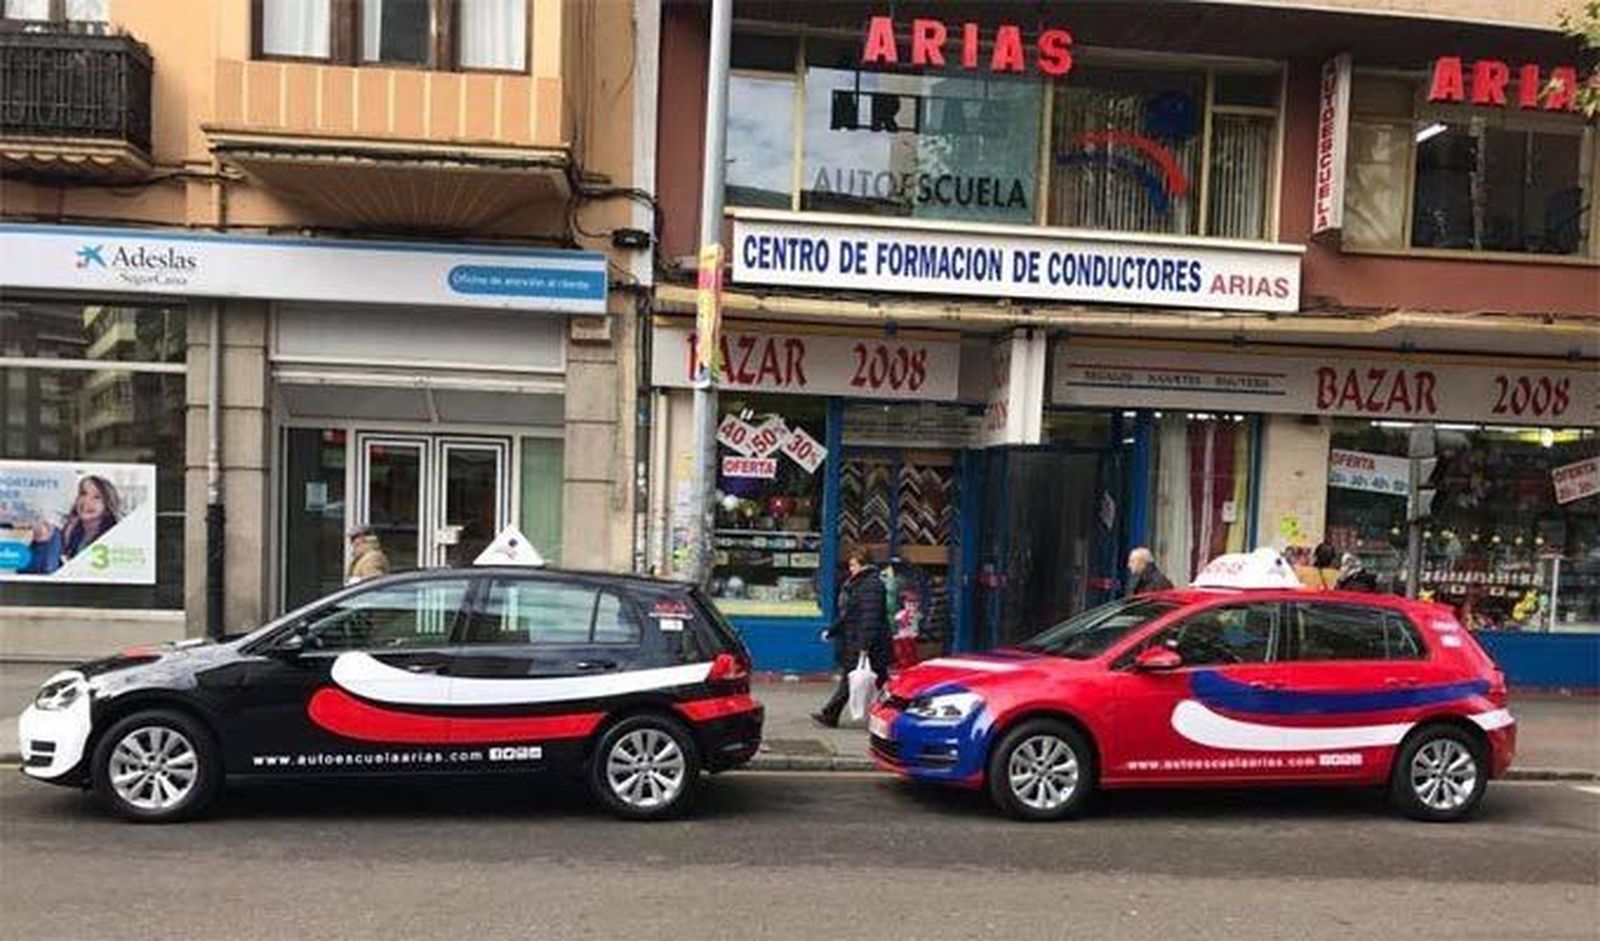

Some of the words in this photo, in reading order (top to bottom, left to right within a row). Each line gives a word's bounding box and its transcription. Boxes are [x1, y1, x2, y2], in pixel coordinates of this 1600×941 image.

[864, 16, 1073, 75] ARIAS
[813, 166, 1027, 209] AUTOESCUELA
[112, 246, 197, 269] Adeslas
[743, 234, 829, 273] CENTRO
[839, 240, 867, 274] DE
[876, 243, 1003, 281] FORMACION
[1012, 250, 1040, 283] DE
[1049, 253, 1202, 293] CONDUCTORES
[1209, 274, 1290, 298] ARIAS
[851, 343, 928, 391] 2008
[1316, 366, 1437, 414] BAZAR
[1492, 374, 1571, 417] 2008
[724, 459, 774, 474] OFERTA
[1330, 451, 1376, 471] OFERTA
[90, 543, 110, 569] 3
[253, 750, 483, 766] www.autoescuelaarias.com
